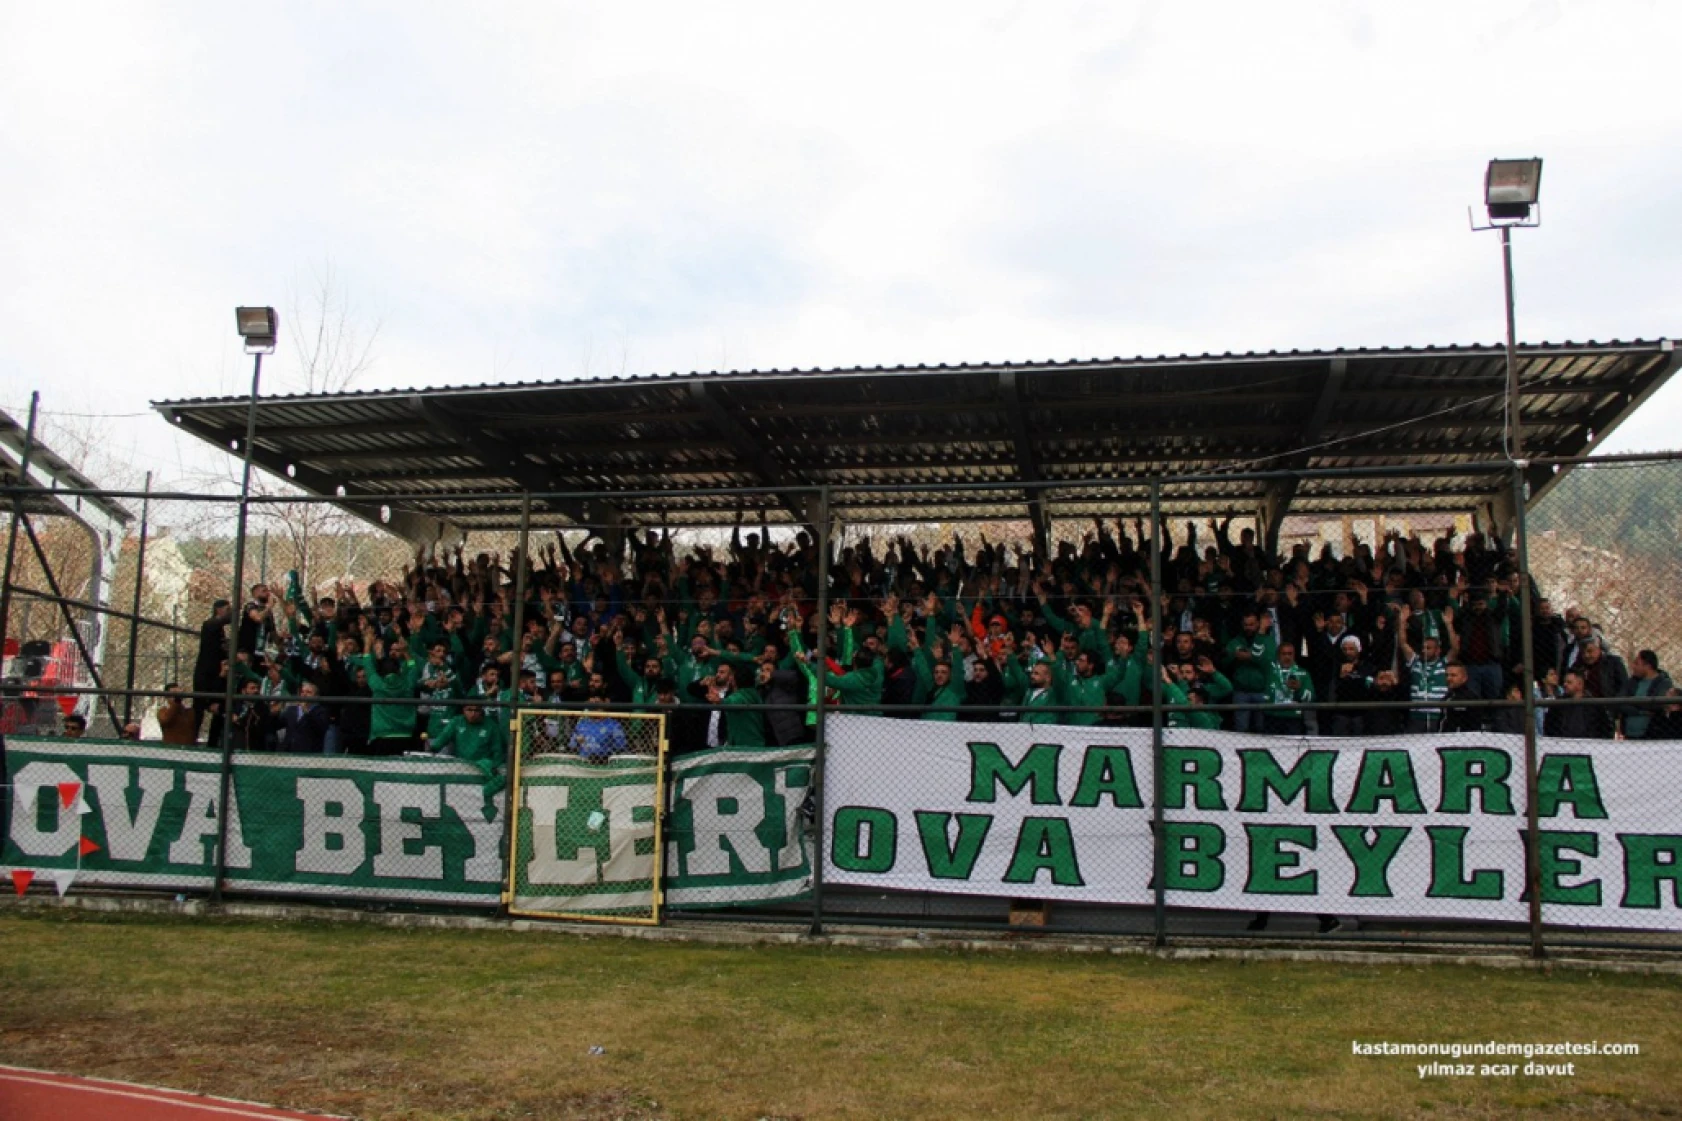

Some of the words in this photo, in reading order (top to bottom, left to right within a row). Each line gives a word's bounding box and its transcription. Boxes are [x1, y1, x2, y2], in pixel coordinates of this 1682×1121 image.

[9, 760, 253, 869] OVA
[965, 741, 1609, 820] MARMARA
[831, 805, 1086, 887] OVA
